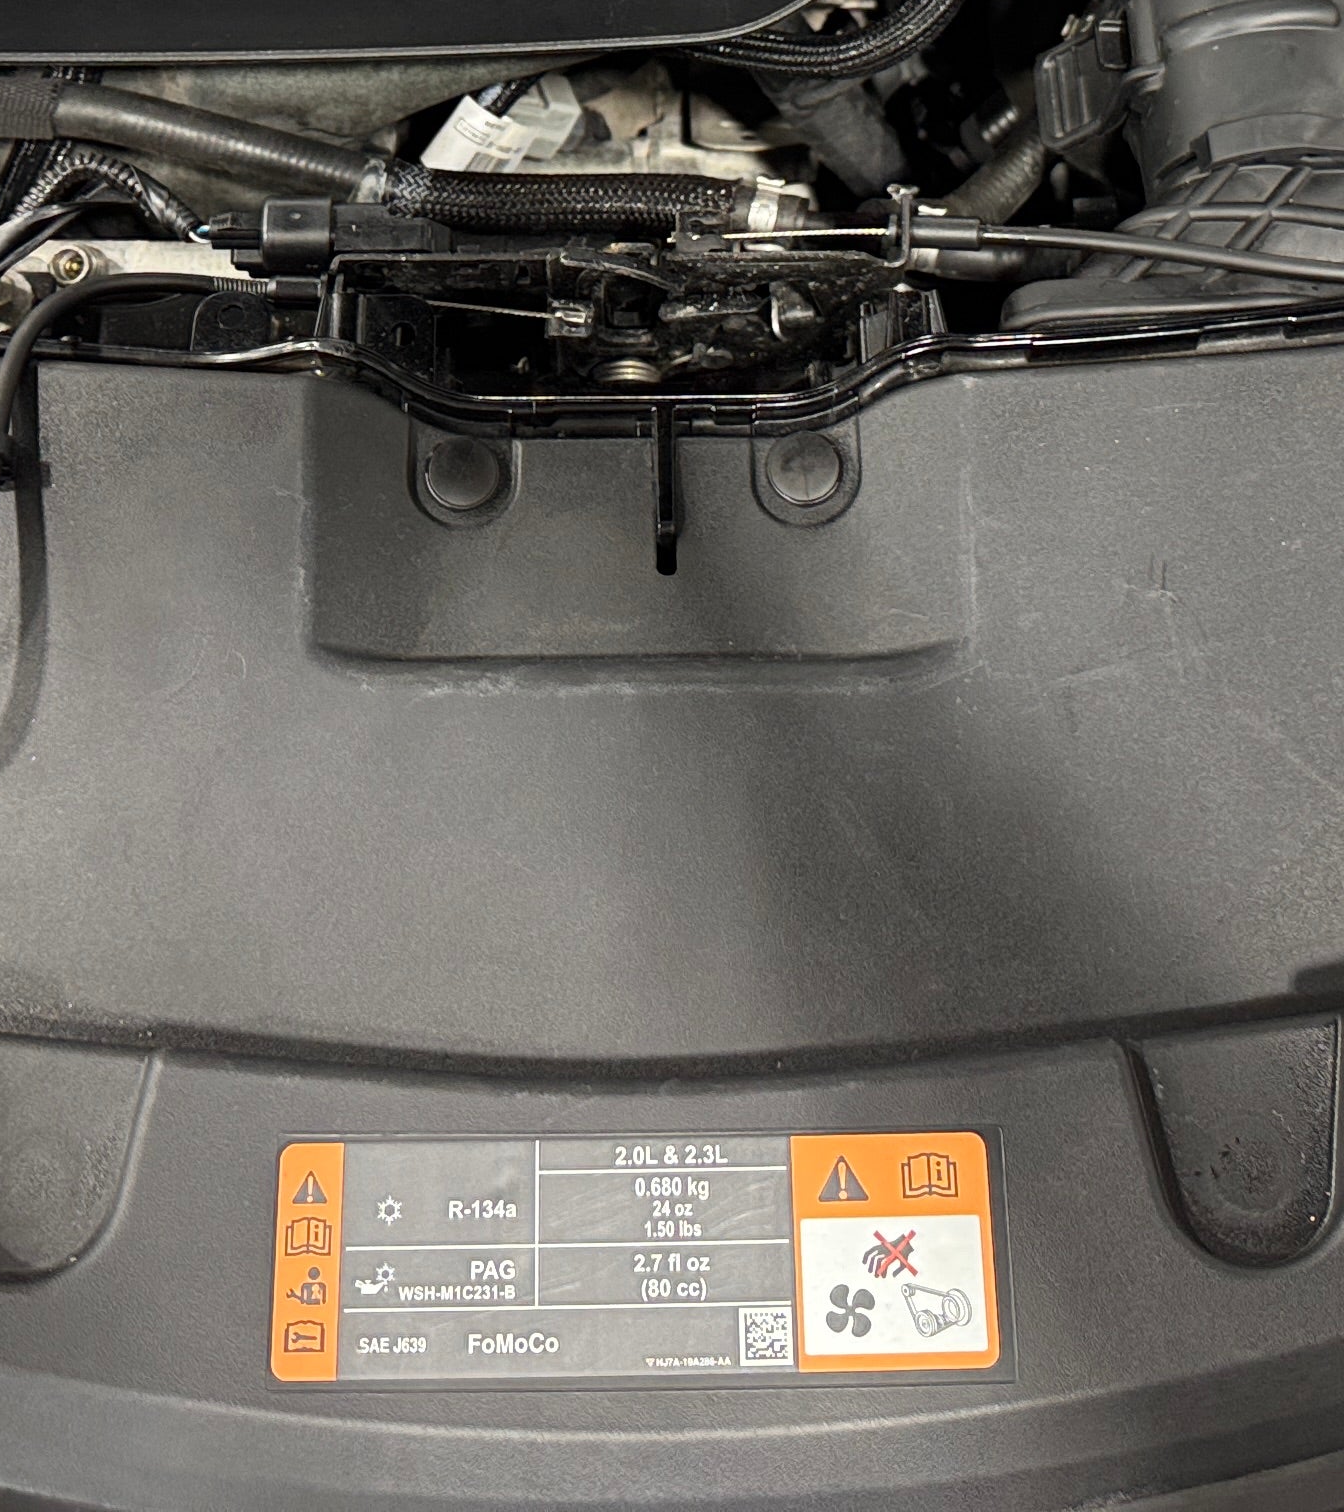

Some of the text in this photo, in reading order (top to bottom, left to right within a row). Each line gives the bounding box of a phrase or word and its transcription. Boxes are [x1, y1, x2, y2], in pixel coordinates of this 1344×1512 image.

[615, 1144, 729, 1166] 2.0L & 2.3L
[634, 1176, 710, 1200] 0.680 kg
[447, 1199, 518, 1219] R-134a
[652, 1200, 694, 1217] 24 oz
[644, 1220, 702, 1238] 1.50 lbs
[469, 1259, 517, 1280] PAG
[633, 1252, 711, 1273] 2.7 fl oz
[398, 1284, 516, 1301] WSH-M1C231-B
[641, 1277, 707, 1302] (80 cc)
[358, 1336, 427, 1354] SAE J639
[467, 1332, 560, 1354] FoMoCo
